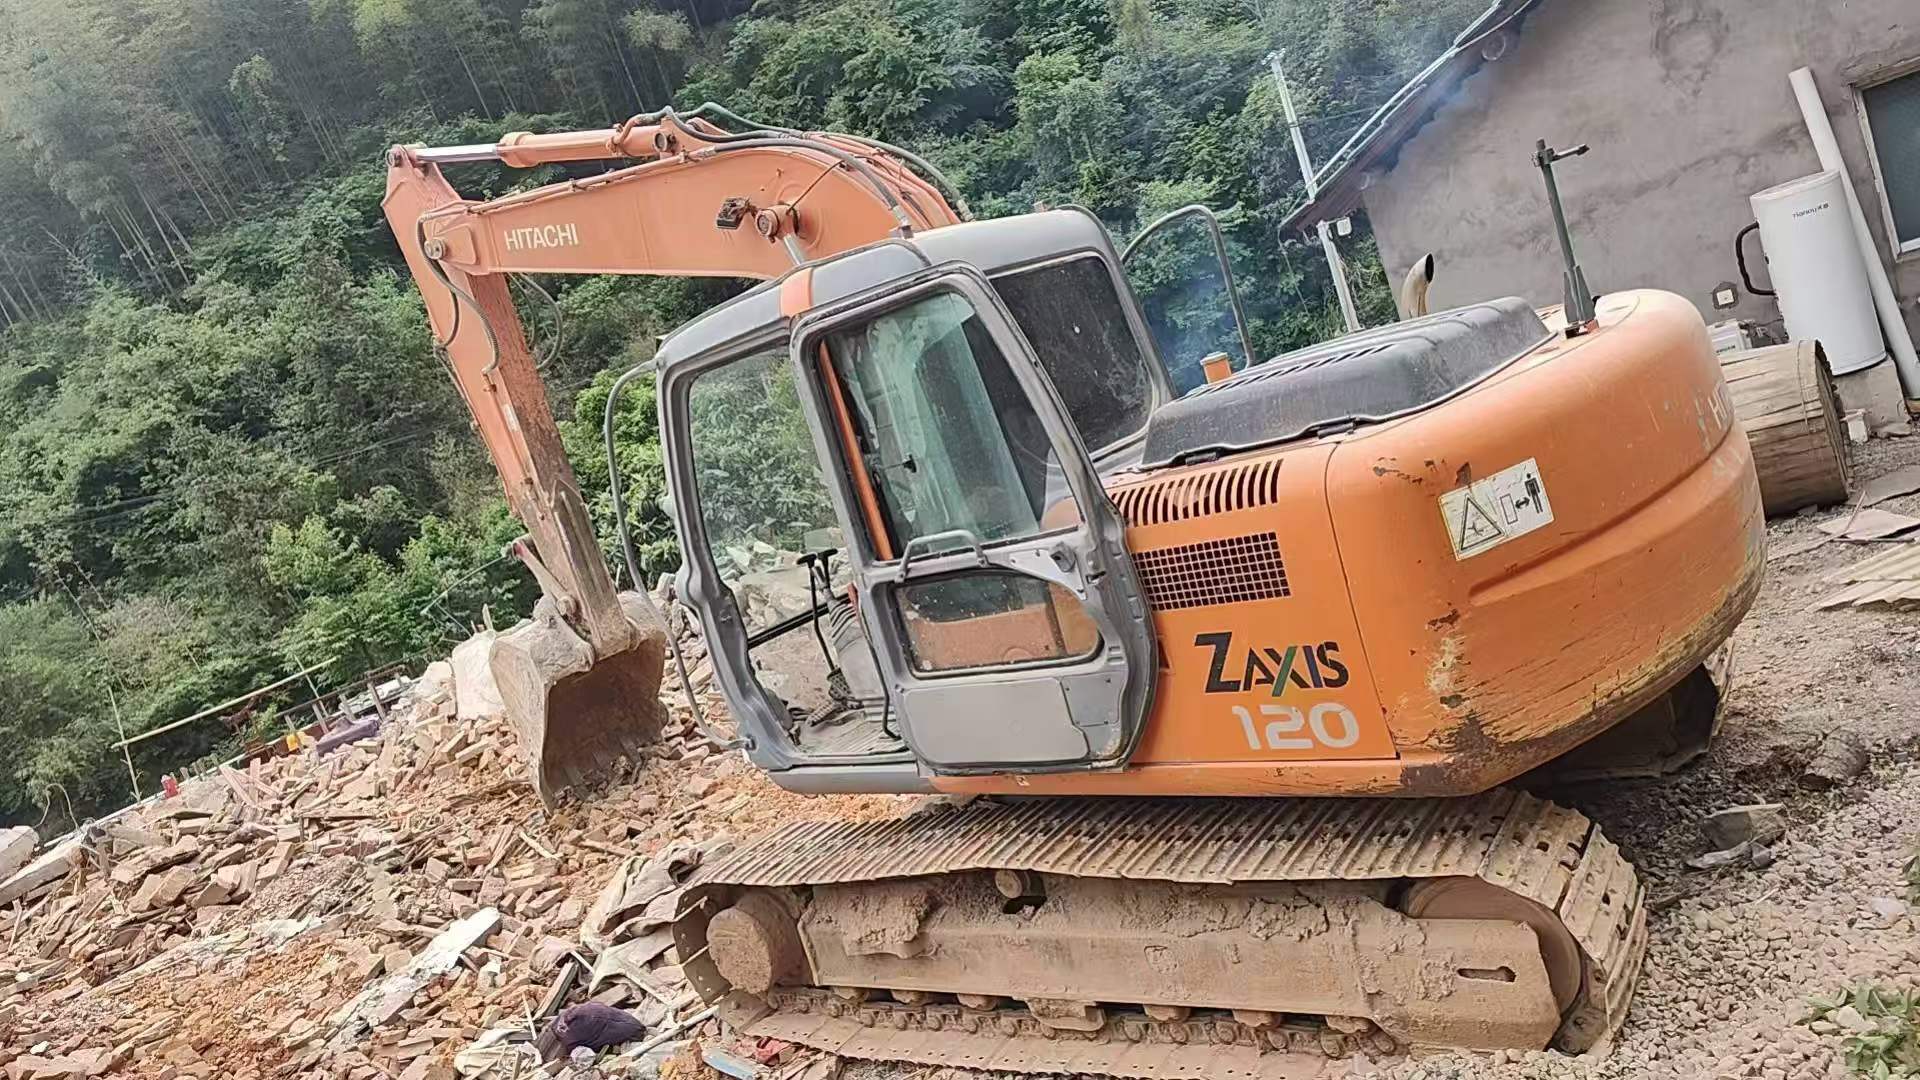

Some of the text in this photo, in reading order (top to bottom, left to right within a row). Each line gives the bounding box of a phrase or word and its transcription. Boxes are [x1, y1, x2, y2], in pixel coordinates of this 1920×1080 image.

[504, 223, 579, 251] HITACHI
[1194, 631, 1349, 697] ZAXIS
[1232, 702, 1360, 750] 120
